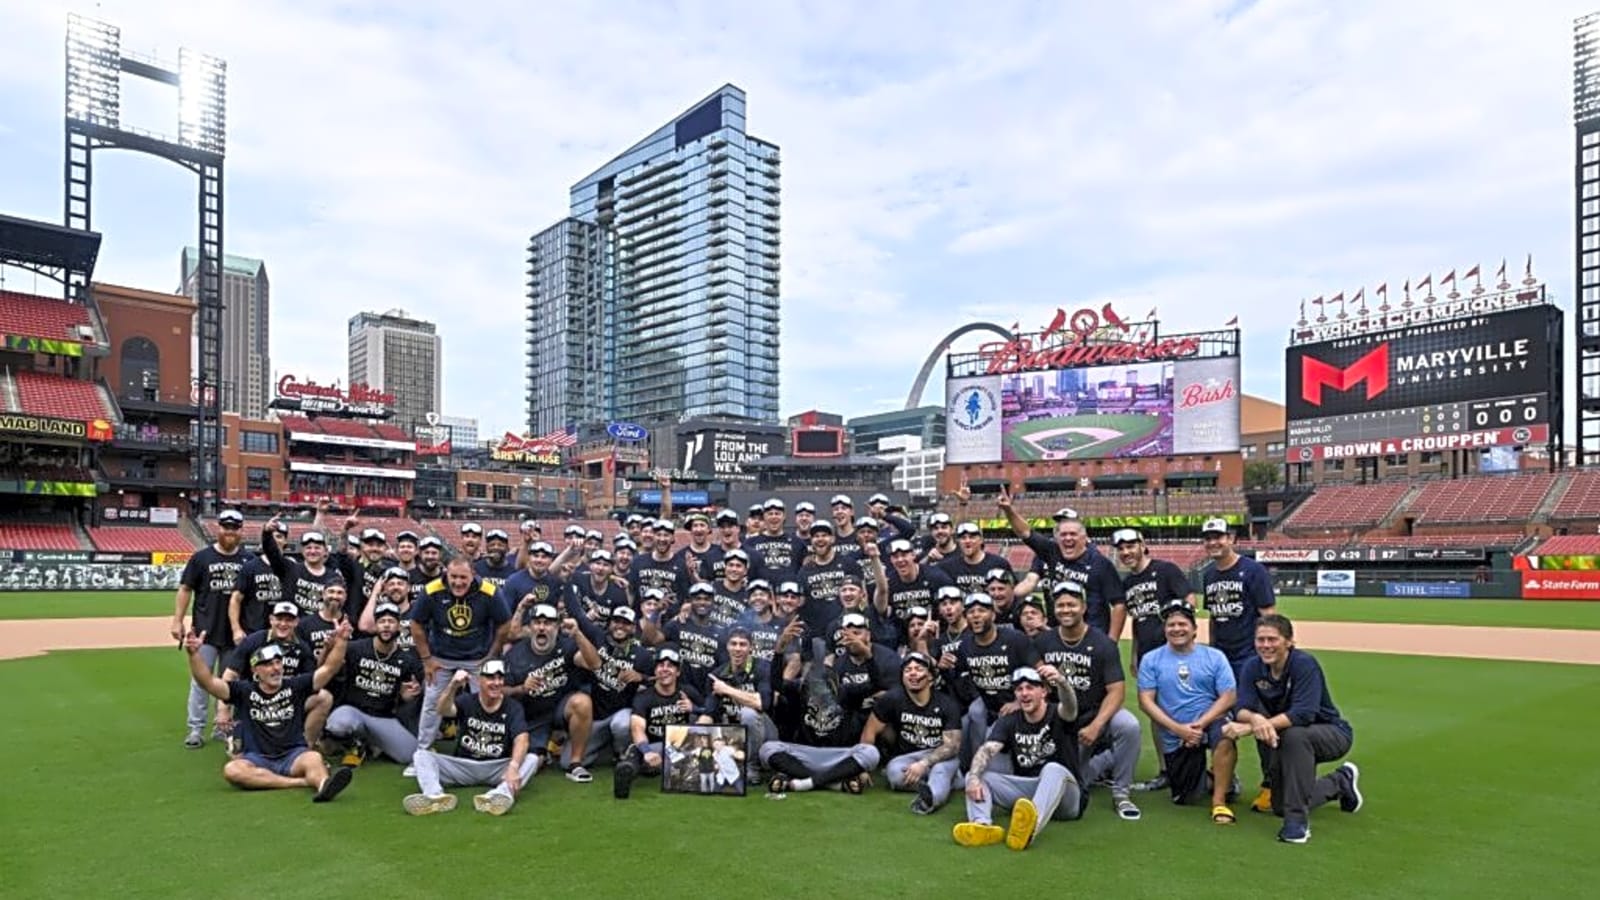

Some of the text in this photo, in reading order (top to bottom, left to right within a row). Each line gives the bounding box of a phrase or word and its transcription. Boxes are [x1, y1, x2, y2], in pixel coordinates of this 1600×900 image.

[1312, 294, 1518, 338] WORLD CHAMPIONS
[1332, 336, 1372, 350] TODAY'S
[1375, 330, 1403, 343] GAME
[1406, 323, 1467, 338] PRESENTED
[979, 337, 1201, 374] Budweiser
[1397, 339, 1529, 373] MARYVILLE
[1397, 360, 1528, 384] UNIVERSITY
[278, 374, 343, 399] Cardinals
[1476, 406, 1537, 426] 0 0 0
[40, 418, 86, 438] LAND
[616, 425, 641, 438] Ford
[714, 440, 769, 455] FROM THE
[1323, 441, 1382, 459] BROWN
[1386, 443, 1396, 453] &
[1401, 432, 1497, 452] CROUPPEN
[494, 450, 561, 465] BREW HOUSE
[714, 451, 736, 462] LOU
[1394, 586, 1427, 596] STIFEL
[1542, 580, 1599, 590] State Farm
[892, 589, 931, 603] DIVISION
[679, 630, 719, 649] DIVISION
[360, 657, 402, 676] DIVISION
[967, 655, 1009, 669] DIVISION
[1043, 651, 1093, 668] DIVISION
[467, 717, 506, 735] DIVISION
[900, 711, 943, 728] DIVISION
[461, 735, 505, 754] CHAMPS
